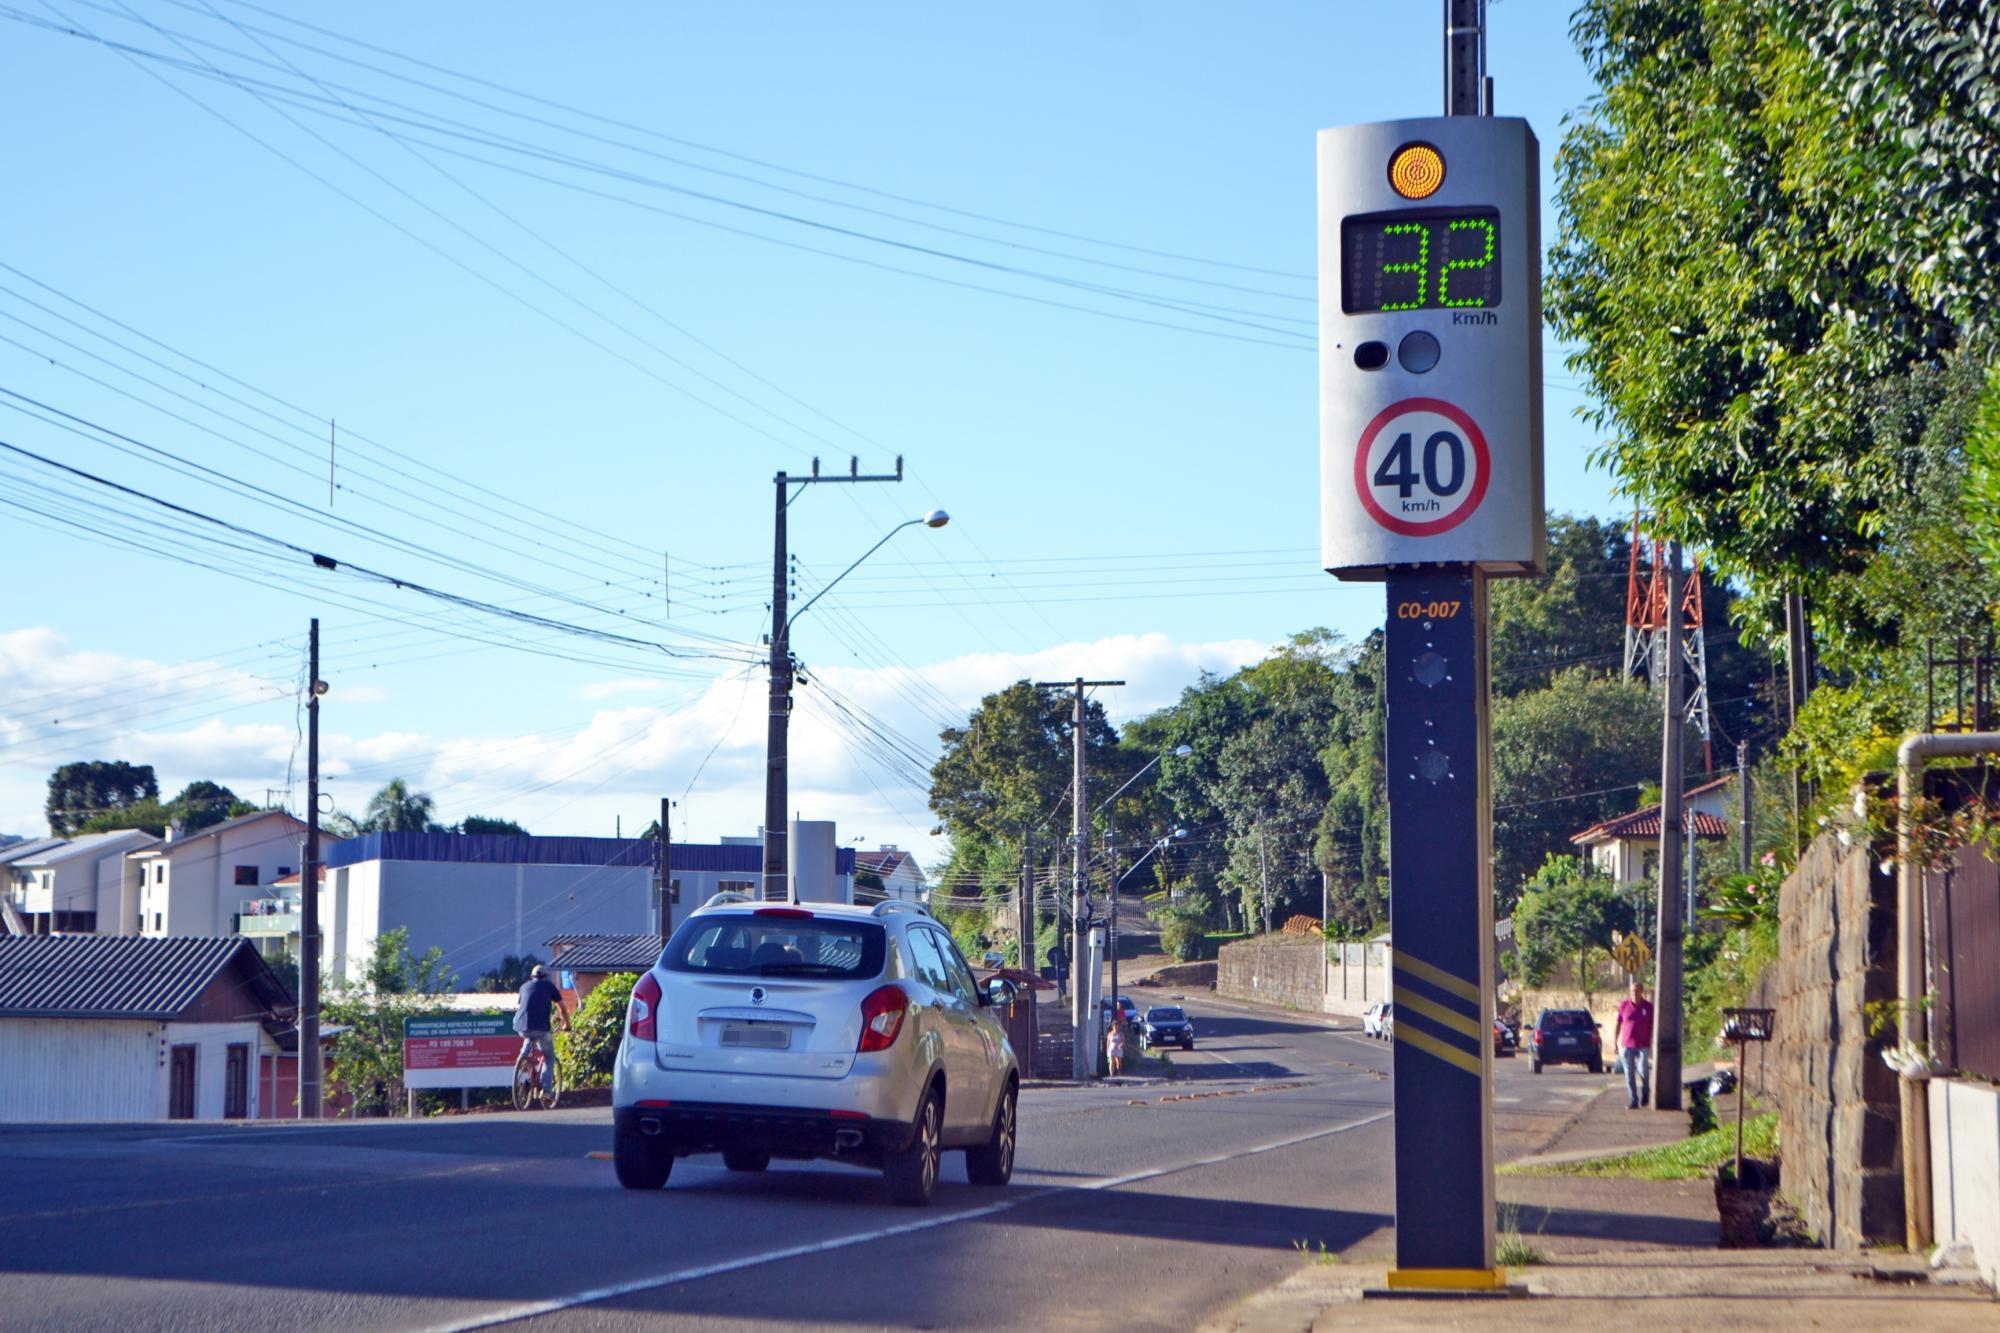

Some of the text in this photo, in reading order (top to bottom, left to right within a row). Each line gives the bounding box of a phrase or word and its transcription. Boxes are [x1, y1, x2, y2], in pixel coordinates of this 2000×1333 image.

[1381, 218, 1495, 312] 32
[1452, 310, 1498, 326] km/h
[1373, 430, 1466, 499] 40
[1402, 500, 1441, 512] km/h
[1398, 601, 1461, 619] CO-007
